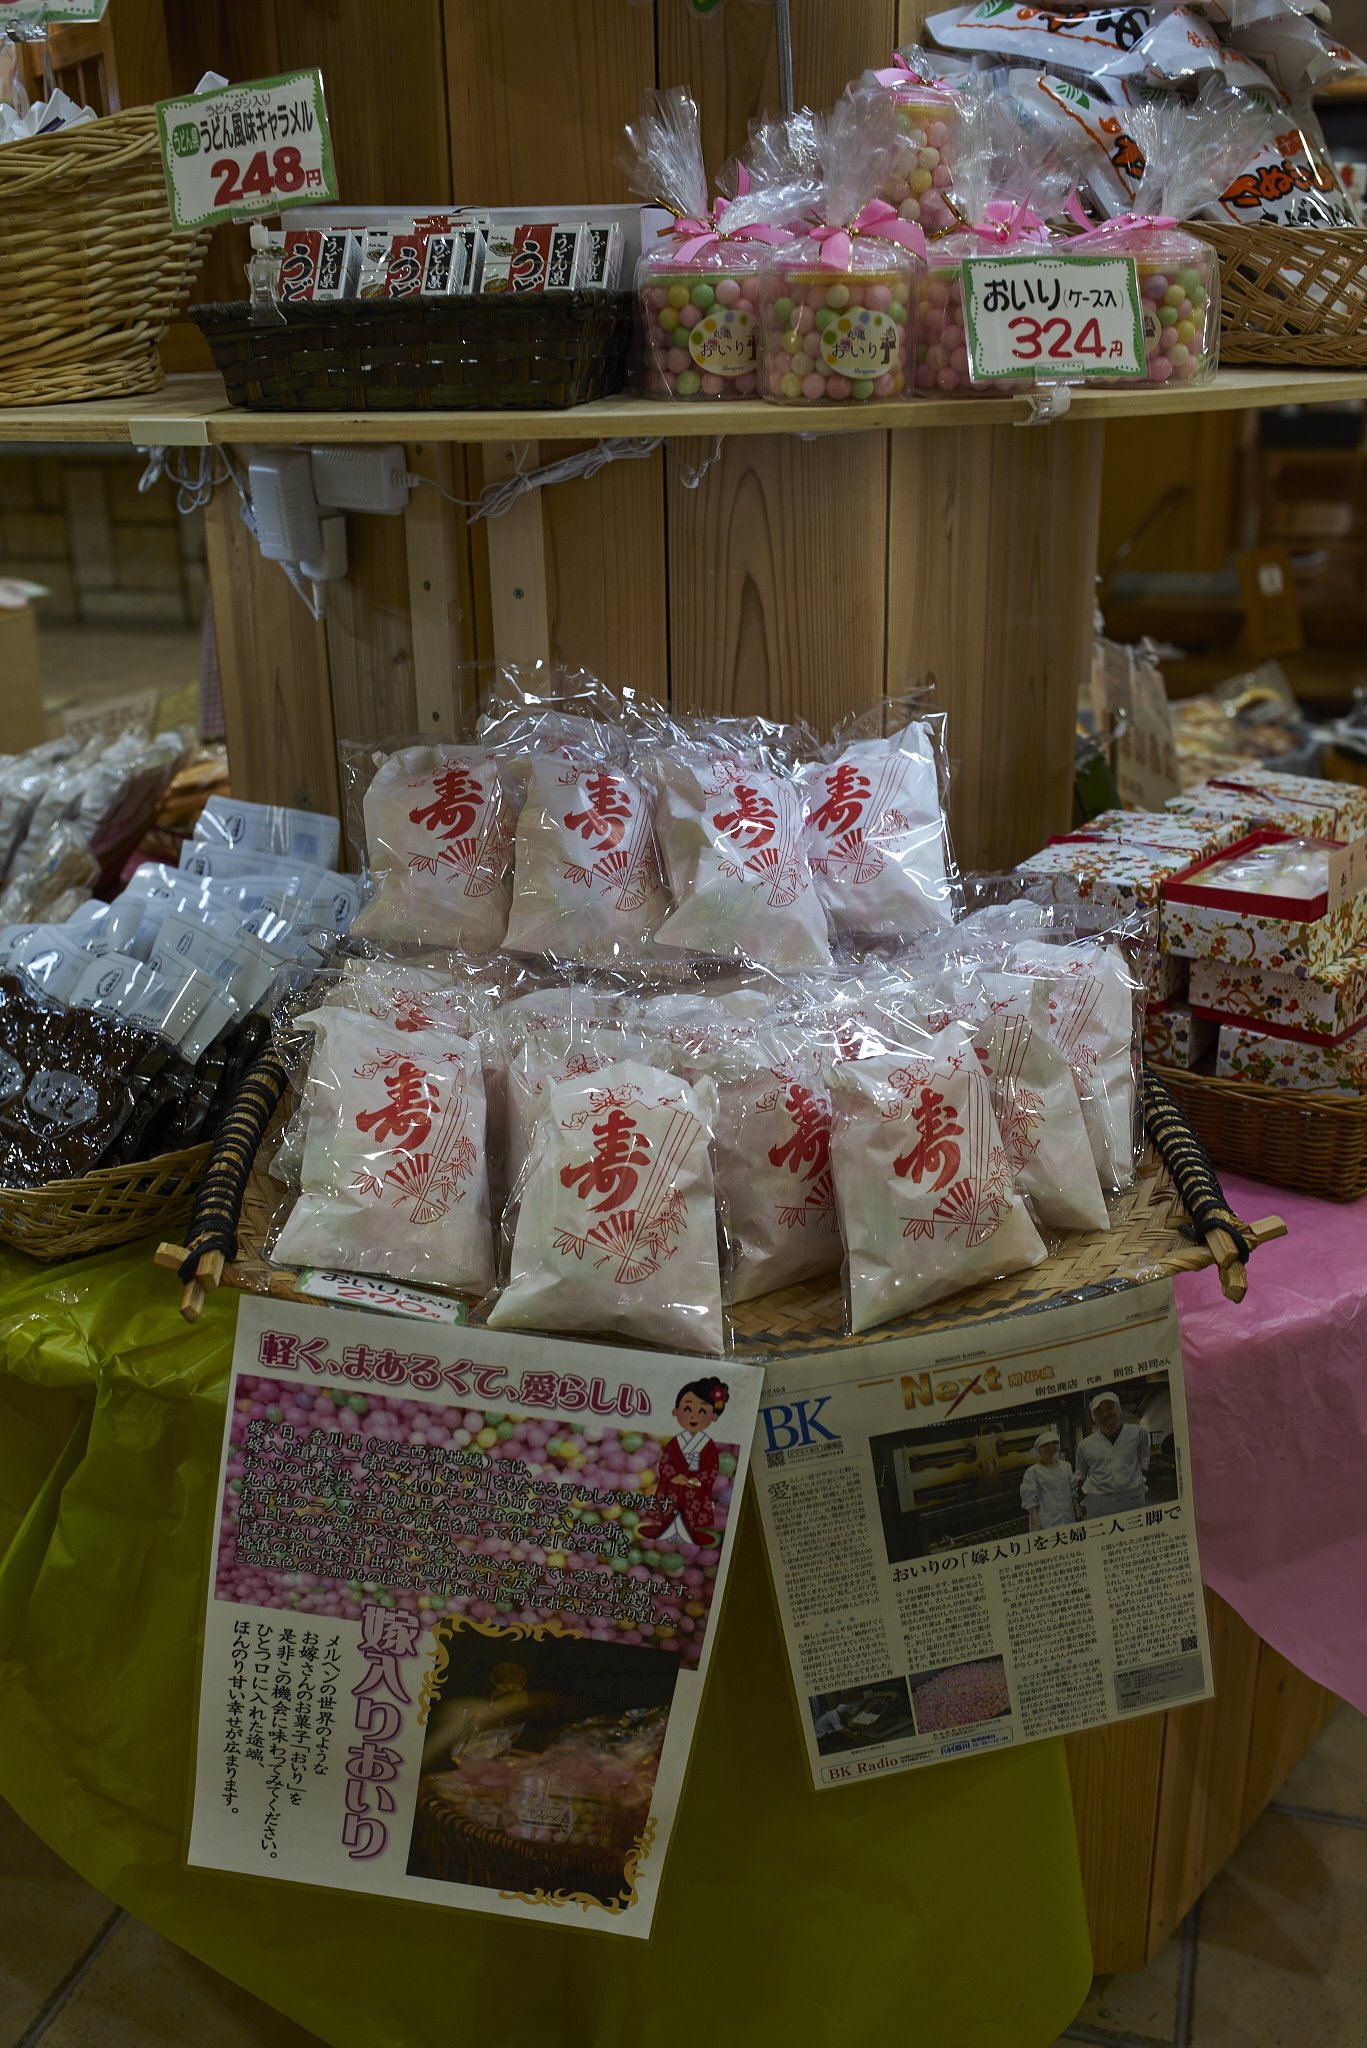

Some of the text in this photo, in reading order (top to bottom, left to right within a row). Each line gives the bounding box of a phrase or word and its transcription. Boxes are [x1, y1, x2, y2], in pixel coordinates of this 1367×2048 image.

[172, 130, 200, 154] うどん県
[200, 100, 313, 154] うどん風味キャラメル
[211, 146, 322, 206] 248円
[550, 235, 573, 285] うどん県
[700, 340, 744, 358] おいり
[713, 330, 732, 340] 丸亀
[832, 341, 877, 359] おいり
[847, 330, 867, 340] 丸亀
[1007, 316, 1123, 360] 324円
[410, 769, 484, 840] 寿
[564, 769, 631, 851] 寿
[713, 785, 777, 849] 寿
[806, 765, 871, 837] 寿
[356, 1062, 440, 1155] 寿
[768, 1083, 832, 1183] 寿
[893, 1087, 964, 1192] 寿
[560, 1110, 651, 1212] 寿
[259, 1331, 651, 1417] 軽く、まあるくて、愛らしい
[899, 1366, 1004, 1410] Next
[1035, 1380, 1078, 1398] 則包商店
[1086, 1375, 1102, 1386] 代表
[759, 1396, 840, 1453] BK
[767, 1479, 791, 1503] 愛
[238, 1502, 459, 1550] 献上したのが始まりとされており、
[891, 1507, 1182, 1584] おいりの「嫁入り」を夫婦二人三脚で
[222, 1620, 251, 1814] ほんのり甘い幸せが広まります。
[246, 1623, 274, 1768] ひとつ口に入れた途端、
[286, 1631, 319, 1806] お嫁さんのお菓子「おいり」を
[313, 1635, 342, 1776] メルヘンの世界のような
[261, 1628, 297, 1859] 是非この機会に味わってみてください。
[343, 1604, 420, 1858] 嫁入りおいり
[829, 1757, 898, 1780] BK Radio
